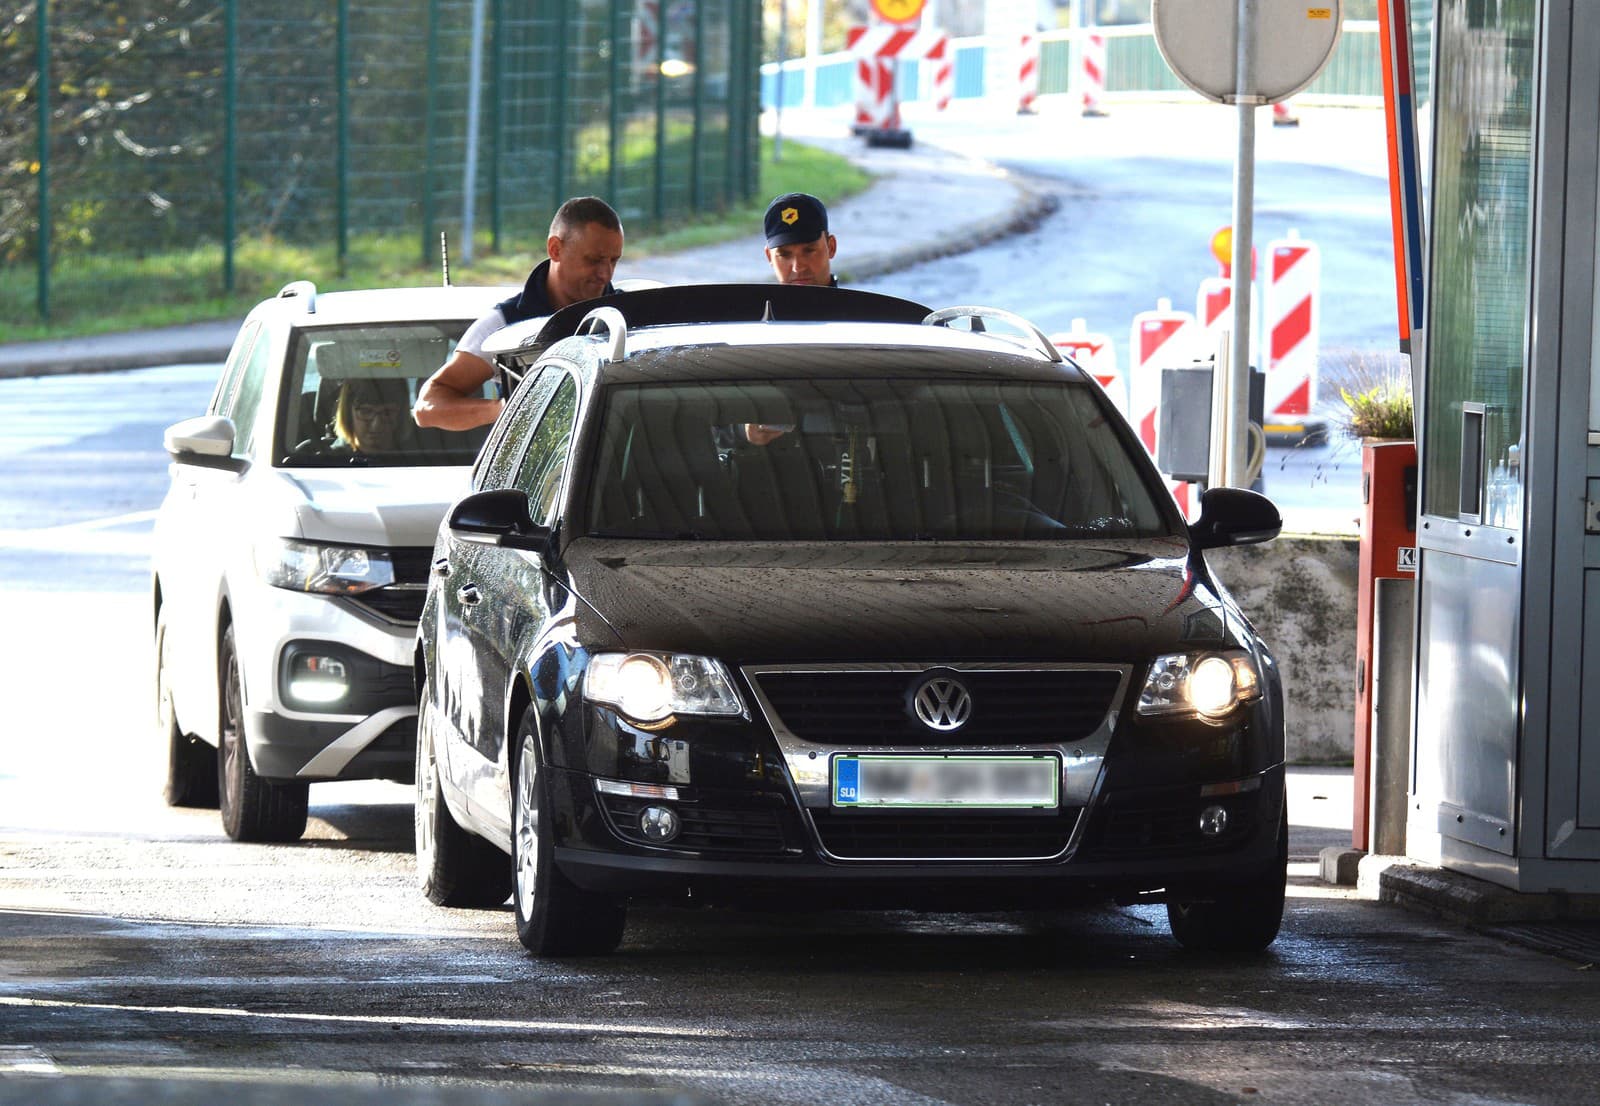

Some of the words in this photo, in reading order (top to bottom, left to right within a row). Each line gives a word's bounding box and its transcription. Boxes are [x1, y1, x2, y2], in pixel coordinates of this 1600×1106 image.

[841, 452, 852, 484] VIP
[914, 678, 971, 731] VW
[840, 787, 856, 798] SLO
